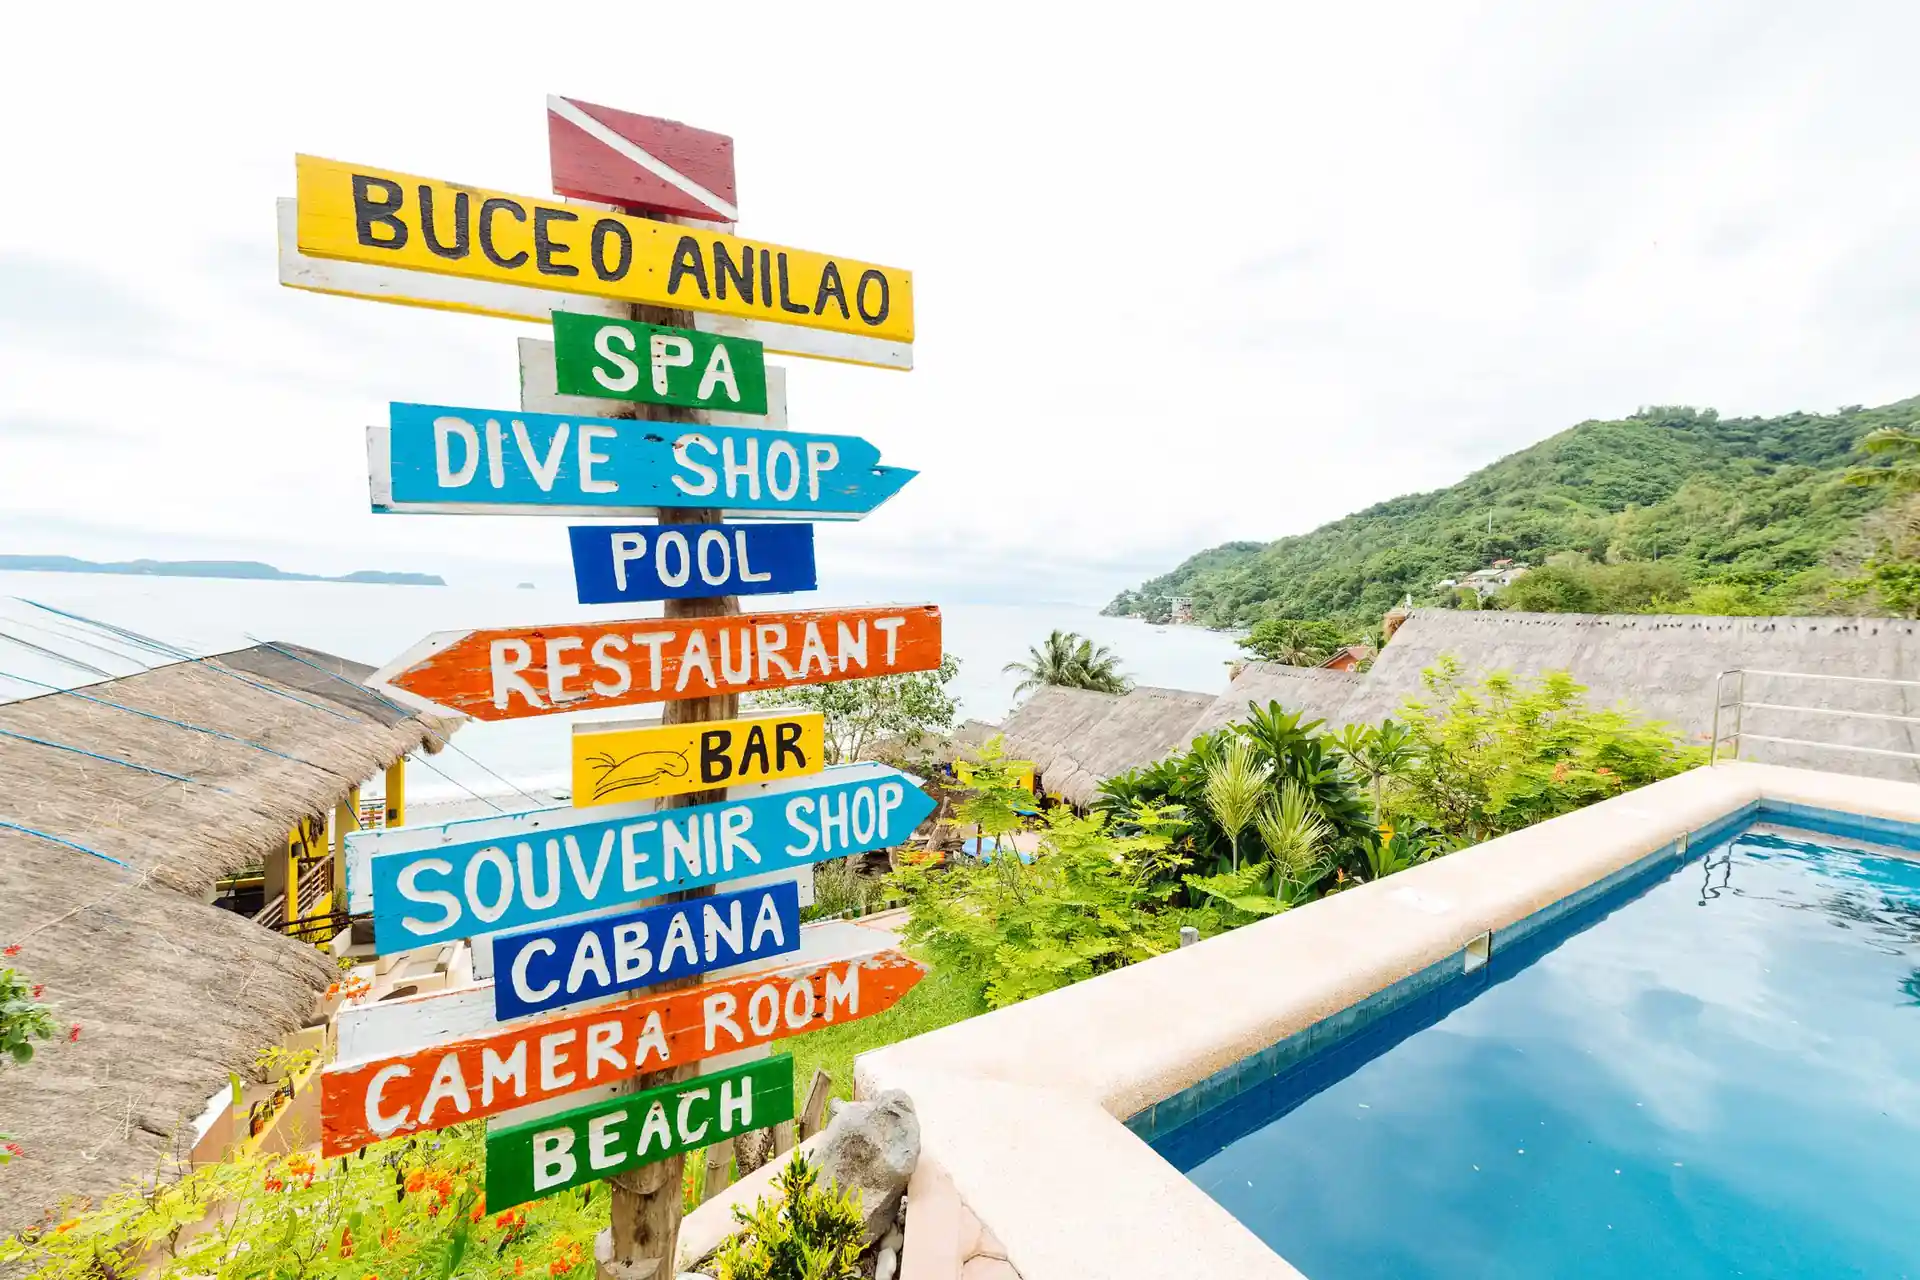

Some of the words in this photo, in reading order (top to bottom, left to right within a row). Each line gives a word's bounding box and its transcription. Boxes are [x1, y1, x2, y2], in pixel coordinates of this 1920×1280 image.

[352, 173, 633, 282] BUCEO
[668, 234, 890, 327] ANILAO
[592, 325, 741, 404] SPA
[434, 416, 619, 494] DIVE
[671, 433, 840, 502] SHOP
[611, 529, 771, 591] POOL
[489, 616, 907, 710] RESTAURANT
[699, 724, 806, 784] BAR
[396, 805, 761, 936] SOUVENIR
[785, 780, 904, 858] SHOP
[511, 892, 785, 1004] CABANA
[365, 1018, 677, 1137] CAMERA
[703, 964, 859, 1044] ROOM
[532, 1076, 754, 1192] BEACH
